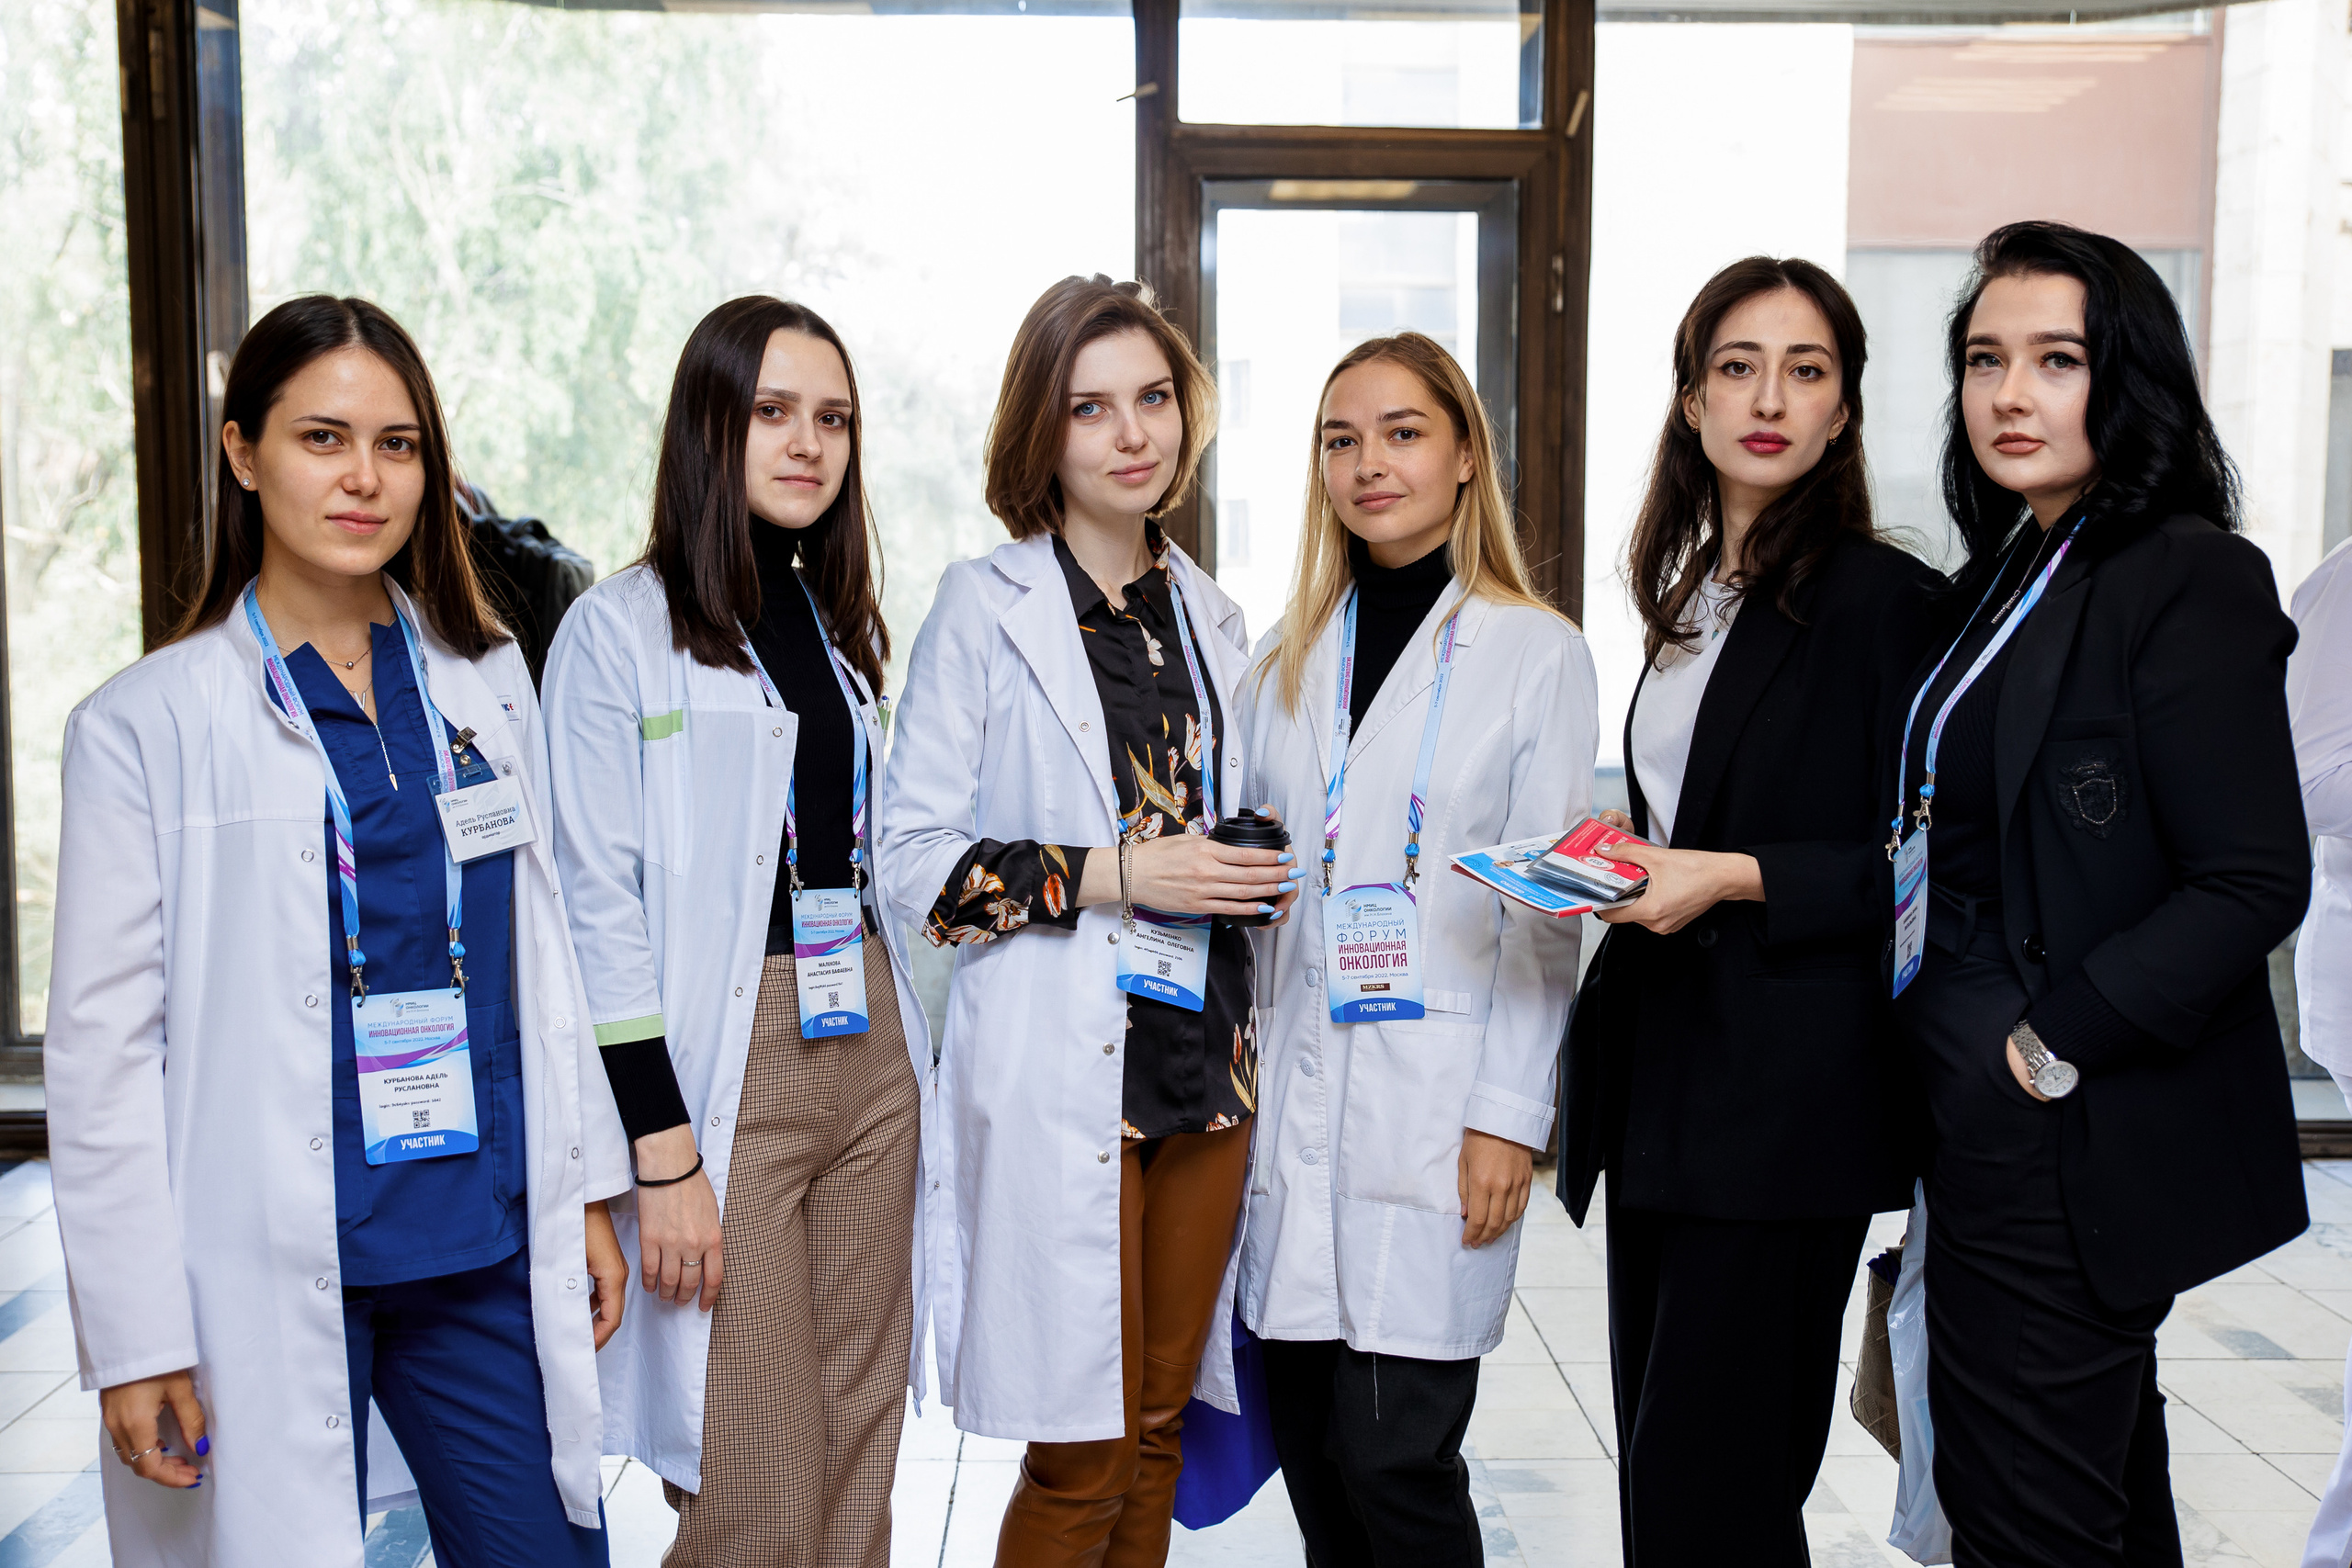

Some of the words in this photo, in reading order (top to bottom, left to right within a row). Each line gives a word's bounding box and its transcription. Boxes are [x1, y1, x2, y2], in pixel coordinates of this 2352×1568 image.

[456, 816, 476, 827] Адель
[477, 806, 515, 821] Руслановна
[461, 816, 514, 837] КУРБАНОВА
[1337, 919, 1405, 930] МЕЖДУНАРОДНЫЙ
[1150, 929, 1182, 941] КУЗЬМЕНКО
[1337, 929, 1407, 942] ФОРУМ
[1136, 933, 1164, 944] АНГЕЛИНА
[1167, 941, 1194, 953] ОЛЕГОВНА
[1339, 941, 1407, 954] ИННОВАЦИОННАЯ
[1340, 953, 1408, 971] ОНКОЛОГИЯ
[1144, 978, 1178, 997] УЧАСТНИК
[1359, 1002, 1396, 1012] УЧАСТНИК
[368, 1017, 428, 1028] МЕЖДУНАРОДНЫЙ
[821, 1016, 848, 1028] УЧАСТНИК
[368, 1025, 419, 1038] ИННОВАЦИОННАЯ
[420, 1023, 454, 1032] ОНКОЛОГИЯ
[383, 1075, 424, 1085] КУРБАНОВА
[425, 1072, 448, 1080] АДЕЛЬ
[394, 1083, 439, 1093] РУСЛАНОВНА
[401, 1134, 446, 1151] УЧАСТНИК
